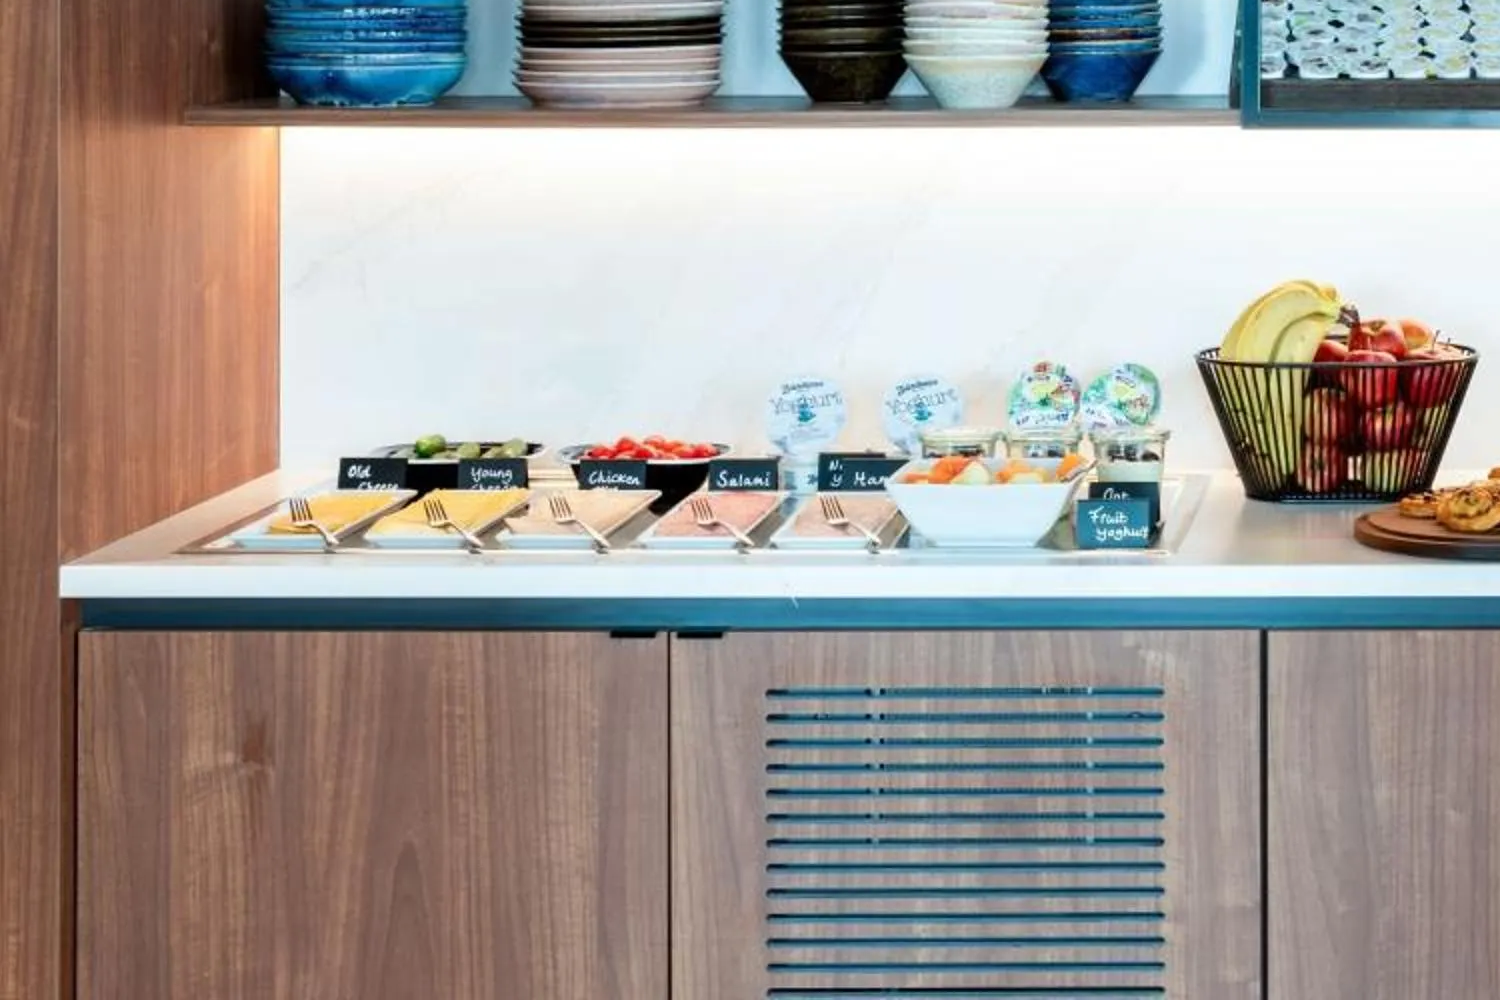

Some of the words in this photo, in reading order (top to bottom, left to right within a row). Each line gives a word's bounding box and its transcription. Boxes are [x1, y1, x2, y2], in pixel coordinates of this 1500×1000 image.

[347, 464, 371, 478] Old
[470, 466, 513, 485] Young
[588, 470, 641, 486] Chicken
[717, 470, 772, 488] Salami
[1088, 505, 1129, 525] Fruit
